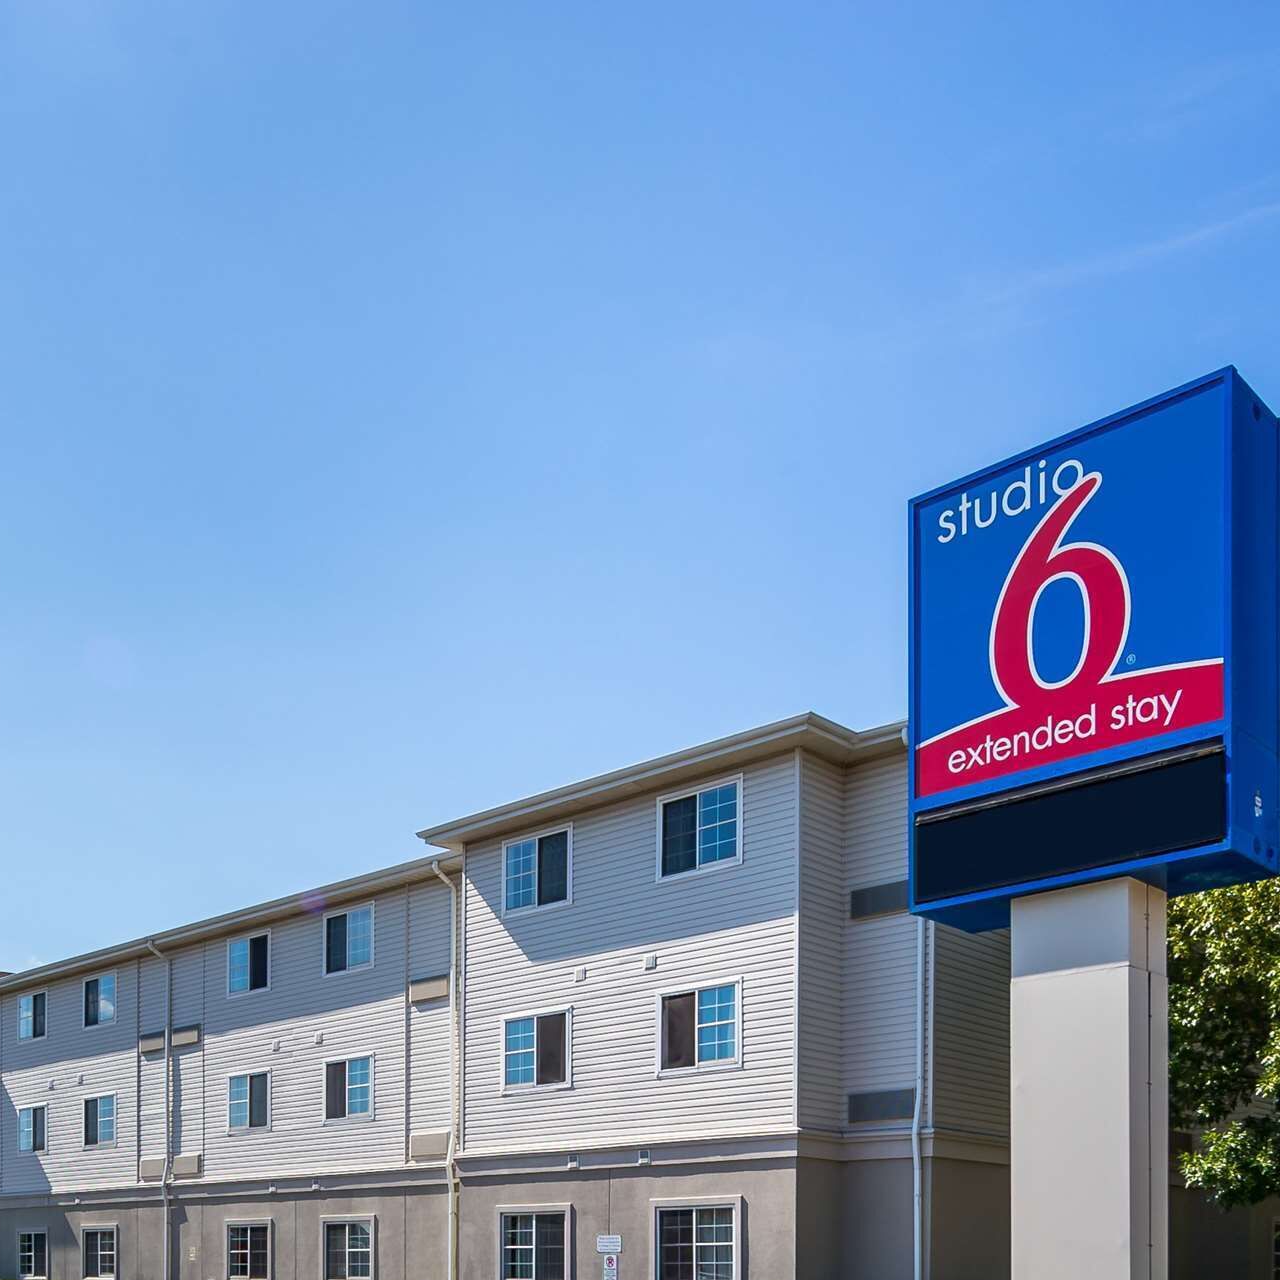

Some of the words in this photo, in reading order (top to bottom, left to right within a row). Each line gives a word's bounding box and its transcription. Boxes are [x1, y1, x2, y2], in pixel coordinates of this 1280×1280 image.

[937, 459, 1084, 544] studio
[989, 471, 1131, 710] 6
[948, 703, 1096, 773] extended
[1110, 689, 1183, 731] stay
